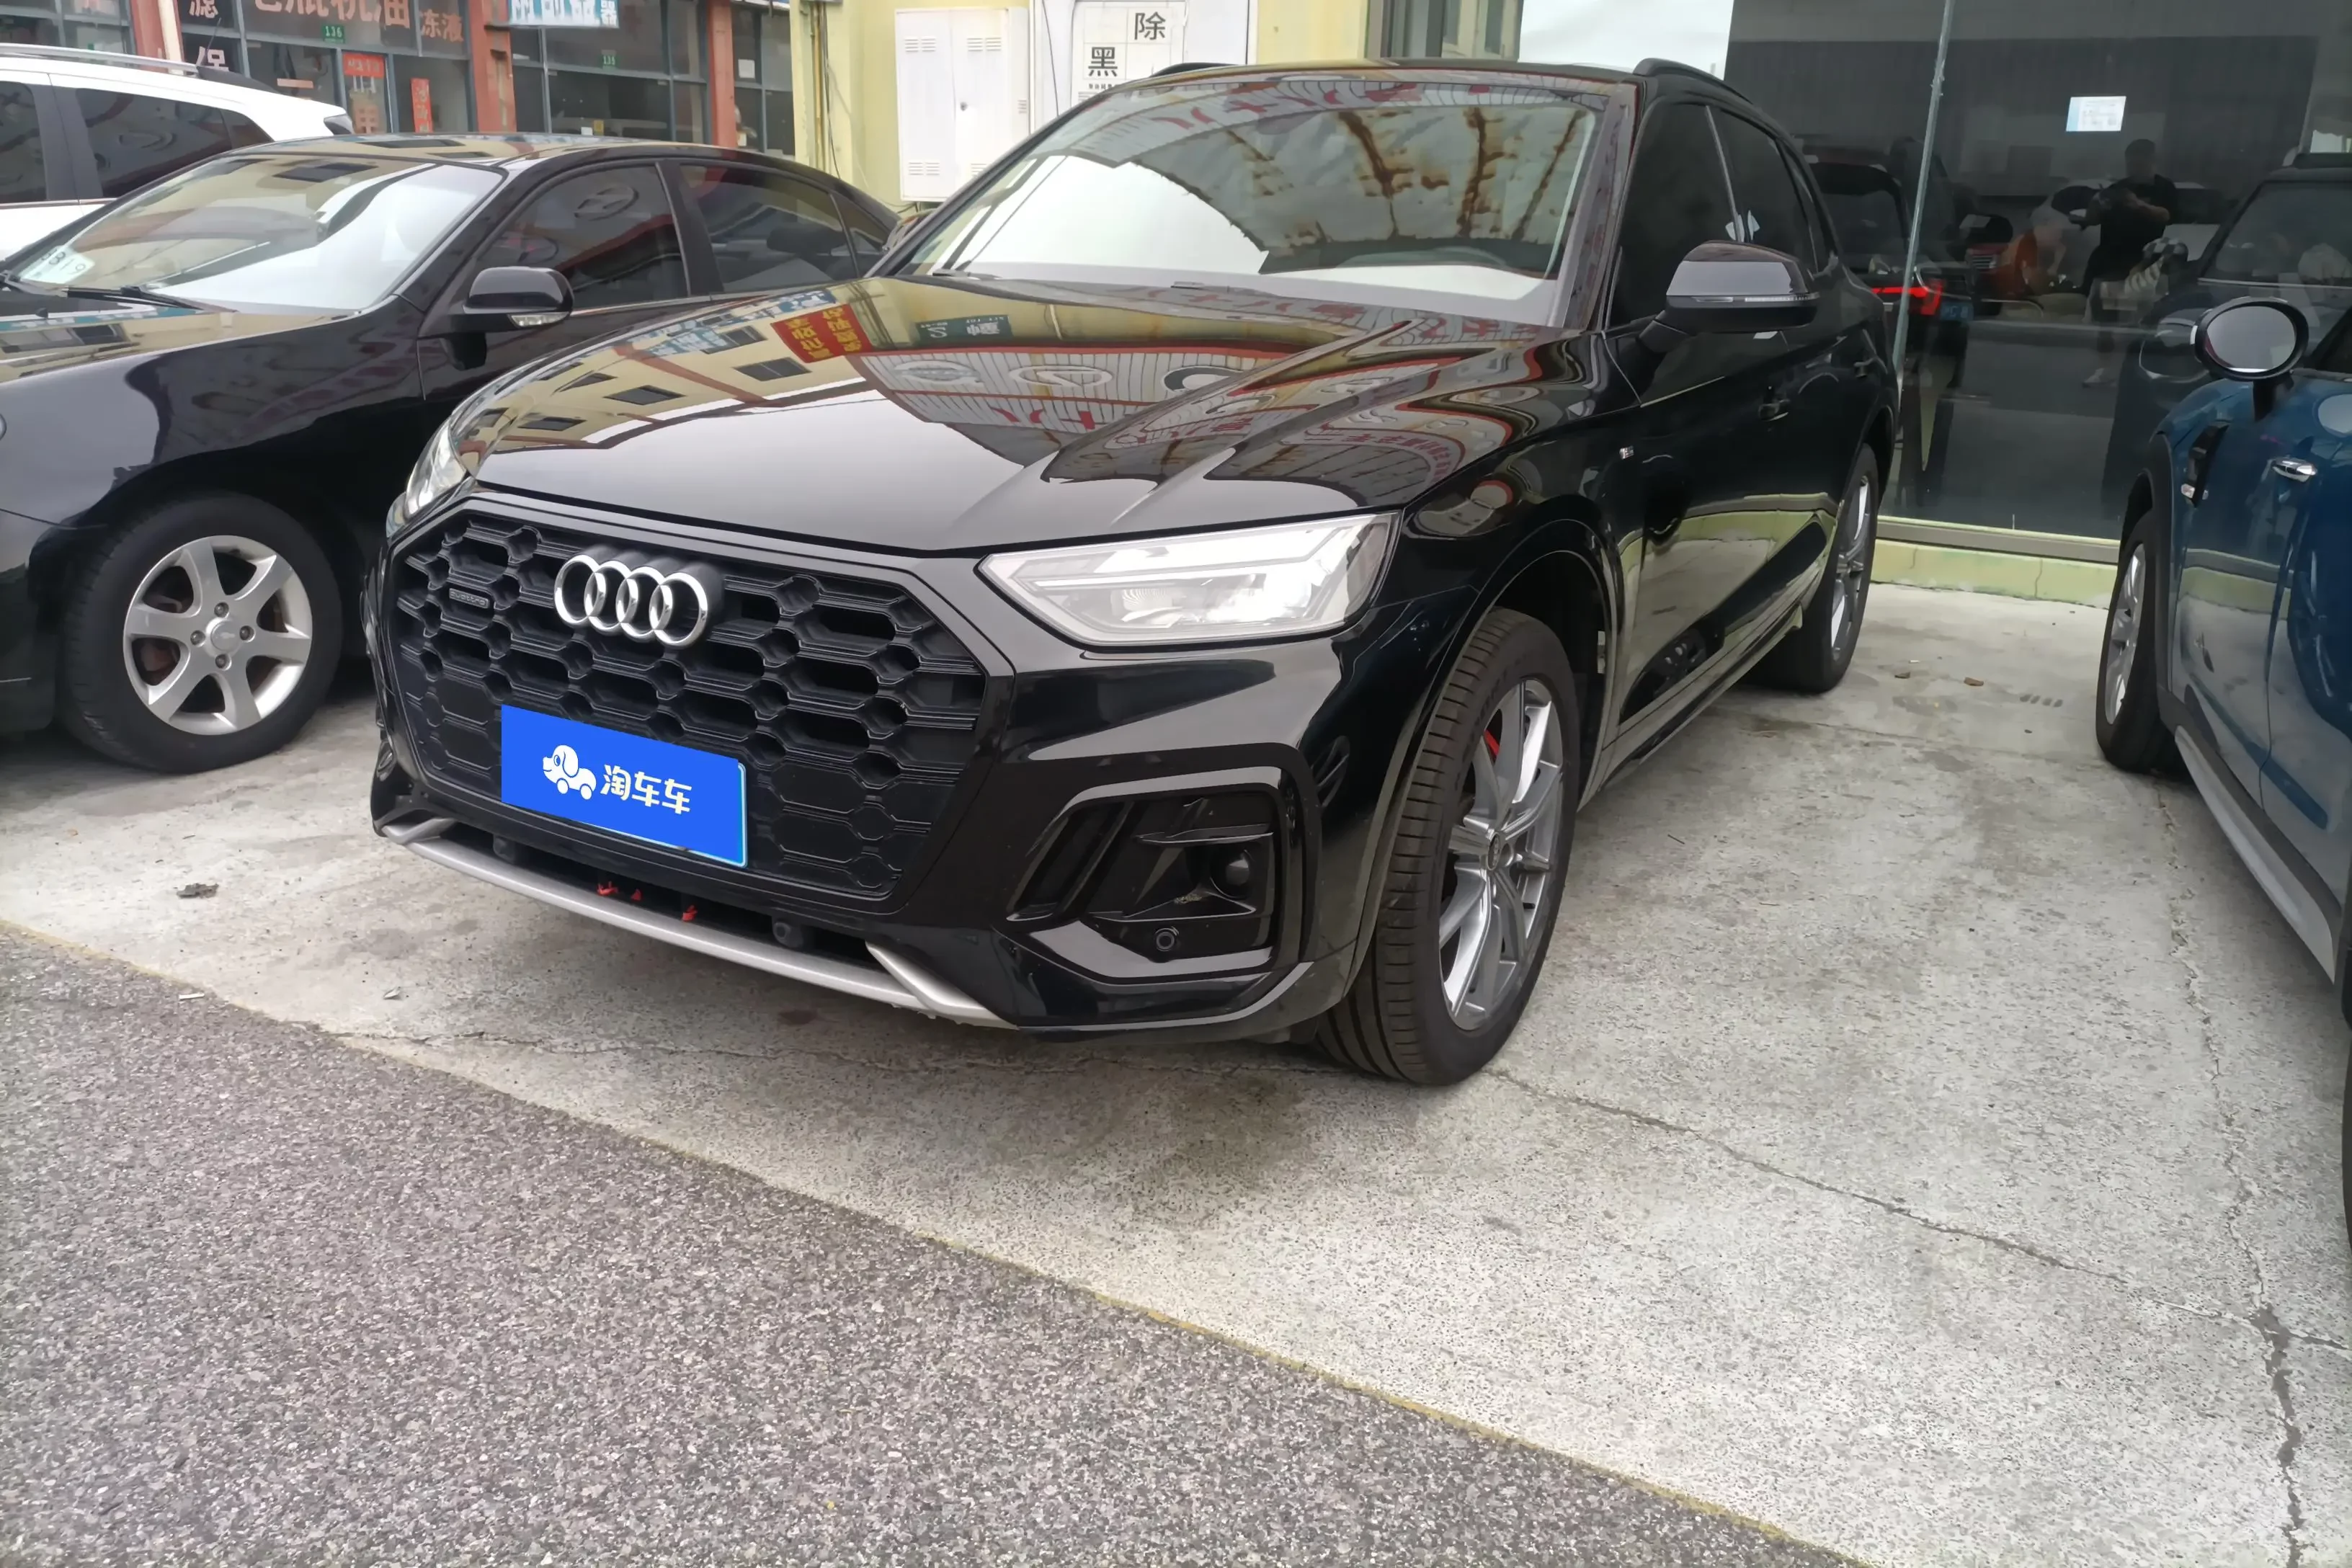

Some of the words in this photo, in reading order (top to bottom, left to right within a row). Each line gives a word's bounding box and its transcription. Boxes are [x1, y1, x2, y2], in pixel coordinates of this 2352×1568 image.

[325, 25, 343, 38] 136
[1134, 12, 1166, 40] 除
[1088, 46, 1118, 76] 黑
